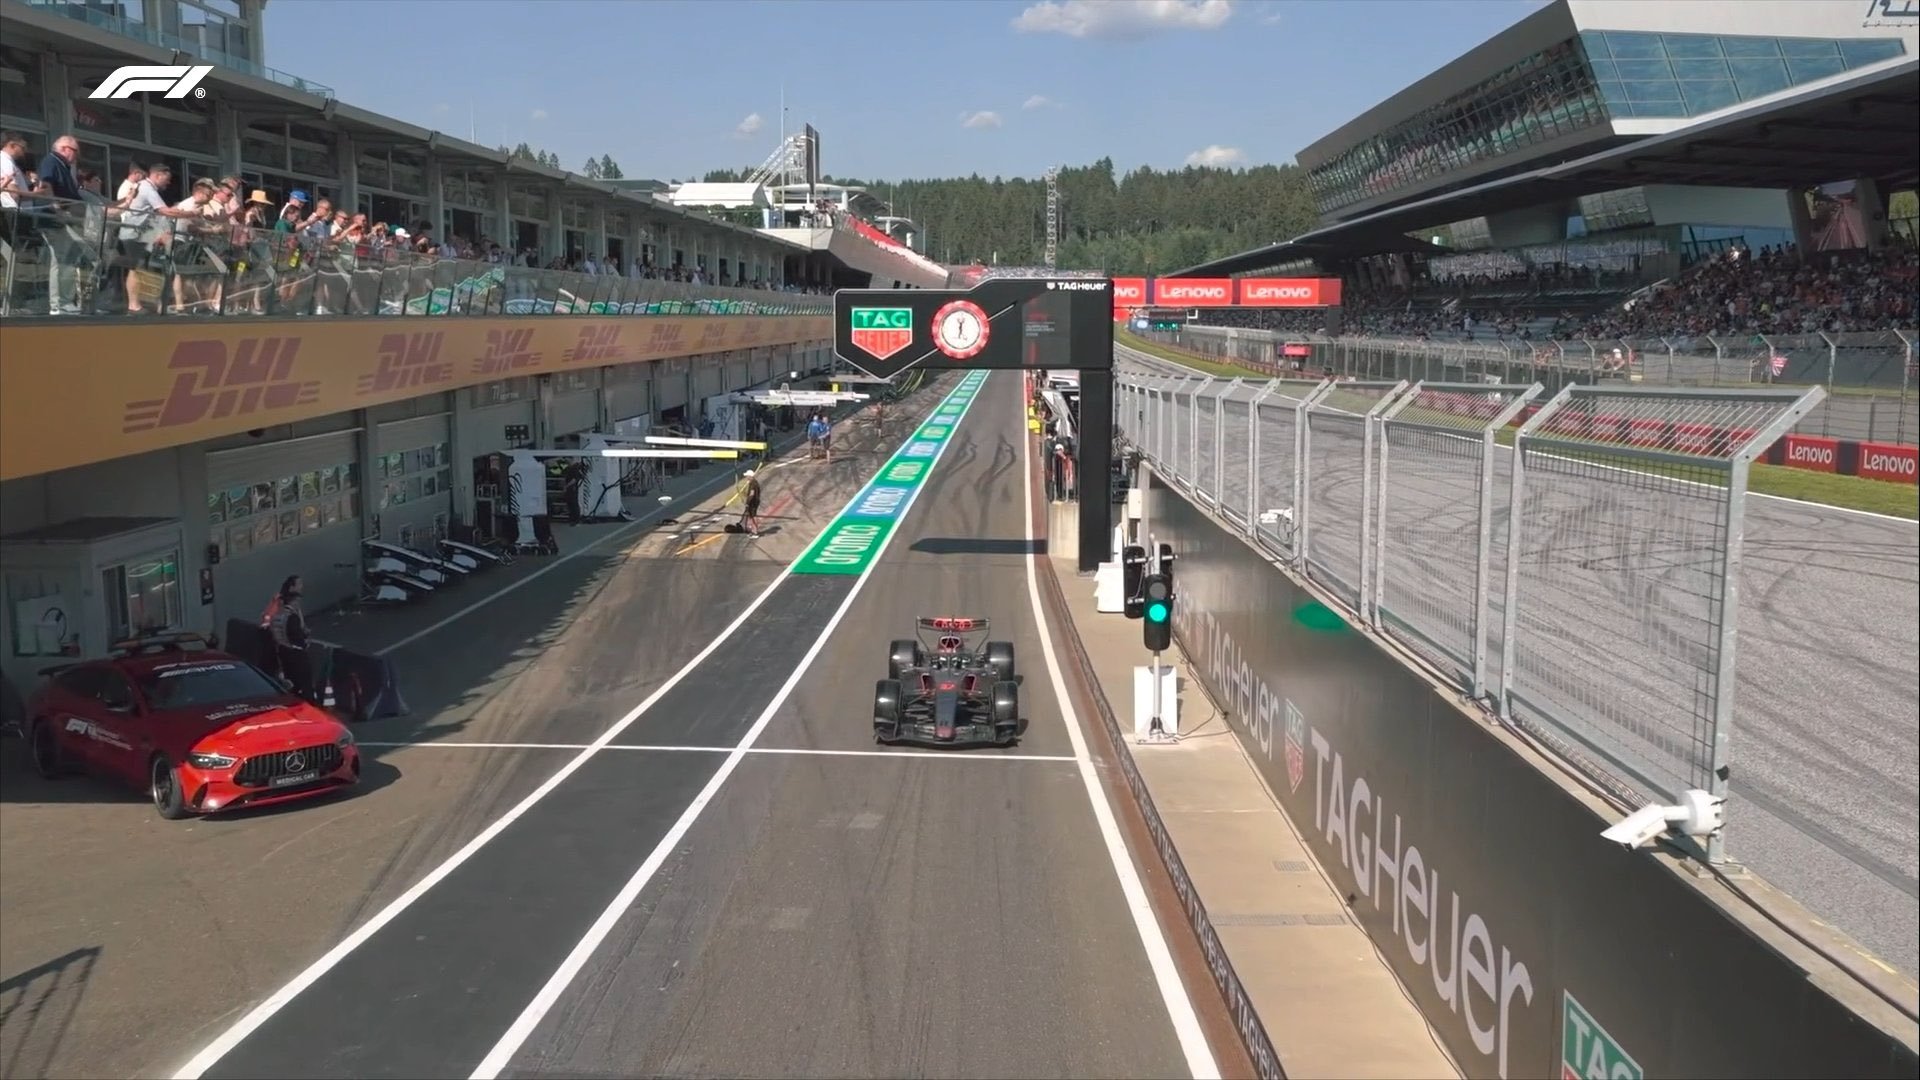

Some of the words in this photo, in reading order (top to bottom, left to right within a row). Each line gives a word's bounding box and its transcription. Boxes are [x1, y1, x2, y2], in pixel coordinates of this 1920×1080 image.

[1161, 284, 1225, 299] Lenovo
[1247, 284, 1312, 299] Lenovo
[857, 312, 907, 327] TAG
[481, 328, 535, 374] DHL
[573, 325, 622, 361] DHL
[855, 331, 909, 355] HEUER
[371, 331, 445, 394] DHL
[158, 337, 301, 428] DHL
[1789, 441, 1833, 464] Lenovo
[1863, 449, 1916, 475] Lenovo
[856, 487, 909, 515] aramco
[814, 524, 882, 565] aramco
[276, 776, 300, 785] MEDICAL
[302, 773, 316, 782] CAR
